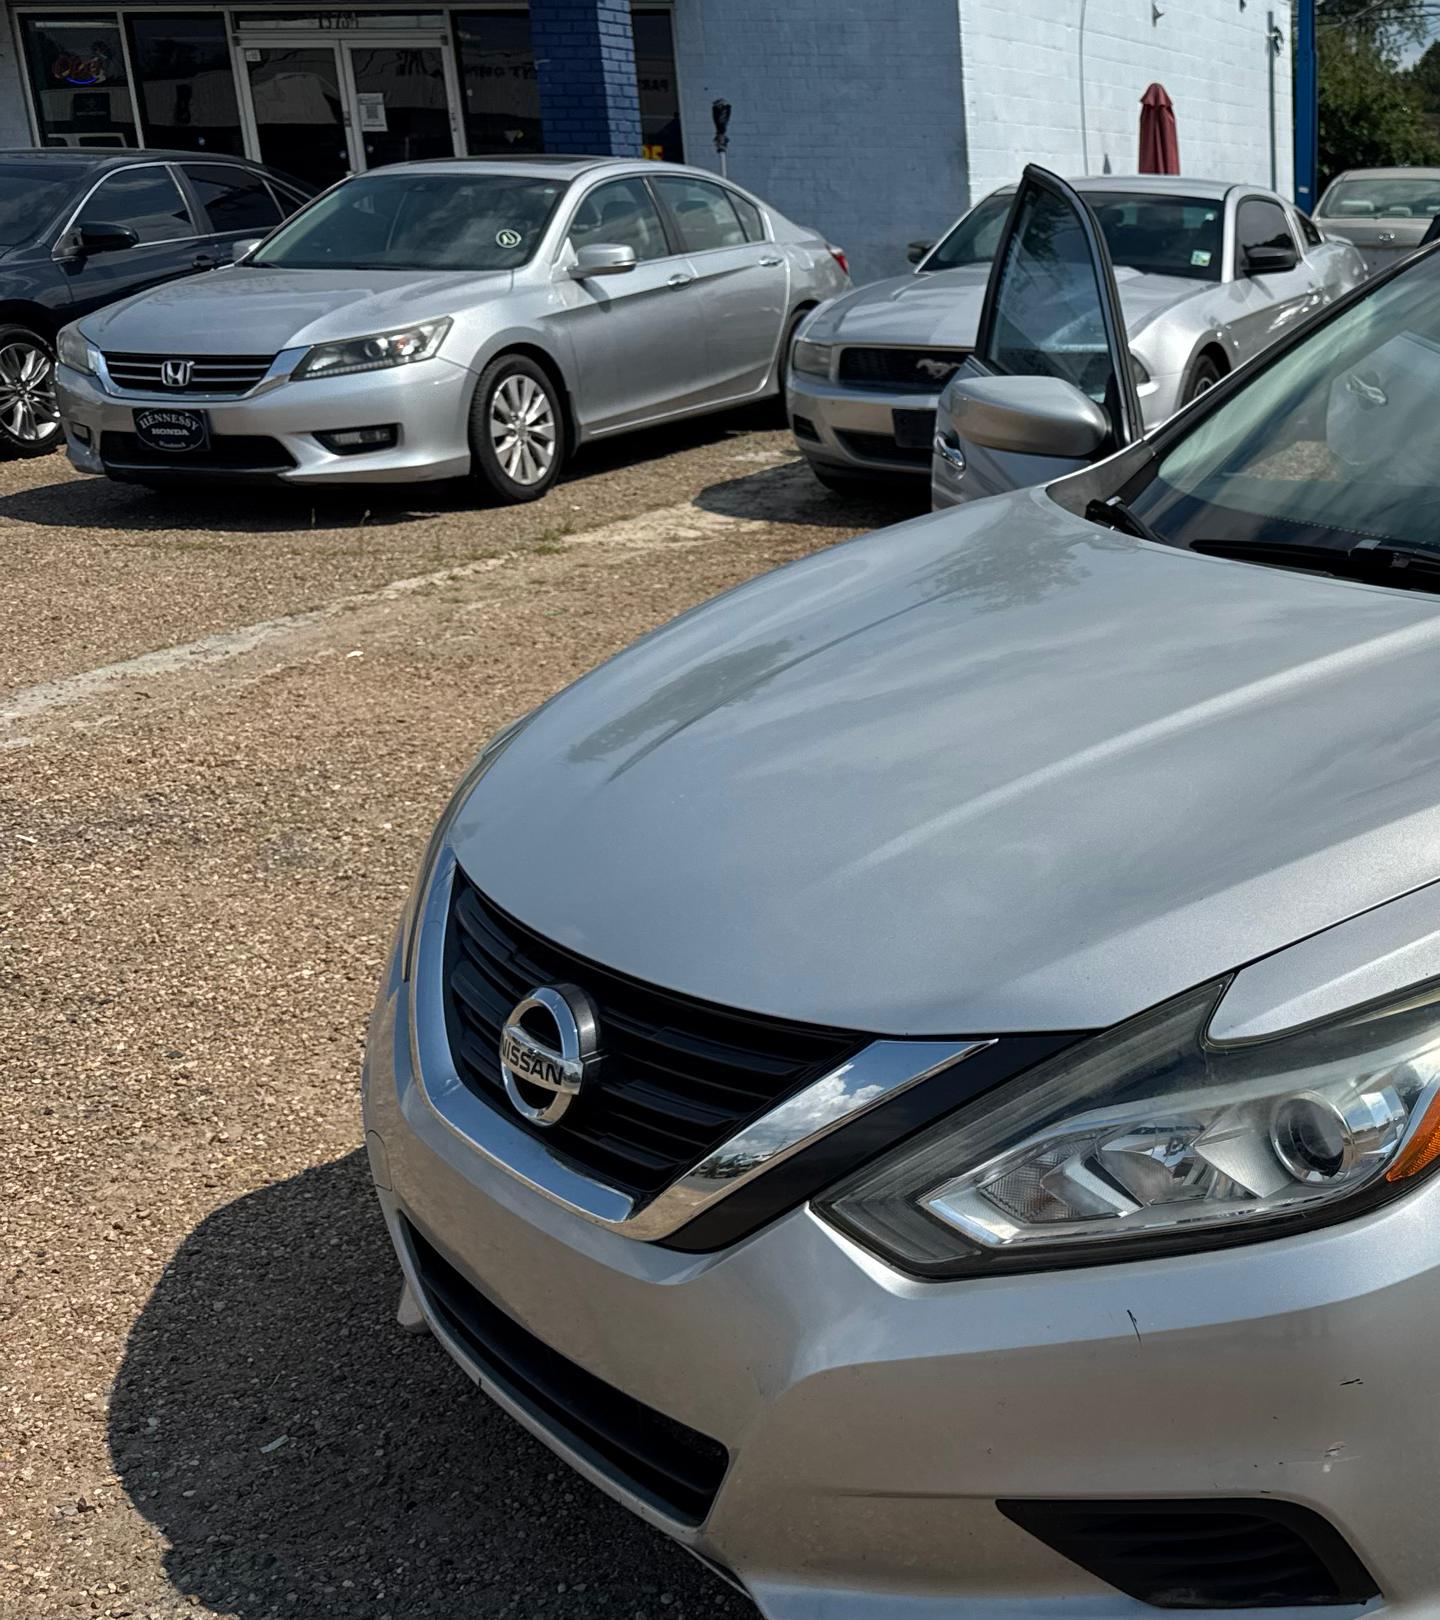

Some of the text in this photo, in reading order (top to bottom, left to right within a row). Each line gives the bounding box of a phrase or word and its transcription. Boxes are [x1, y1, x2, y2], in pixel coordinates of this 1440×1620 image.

[139, 413, 200, 431] HENNESSY
[151, 428, 191, 436] HONDA
[501, 1037, 564, 1086] NISSAN
